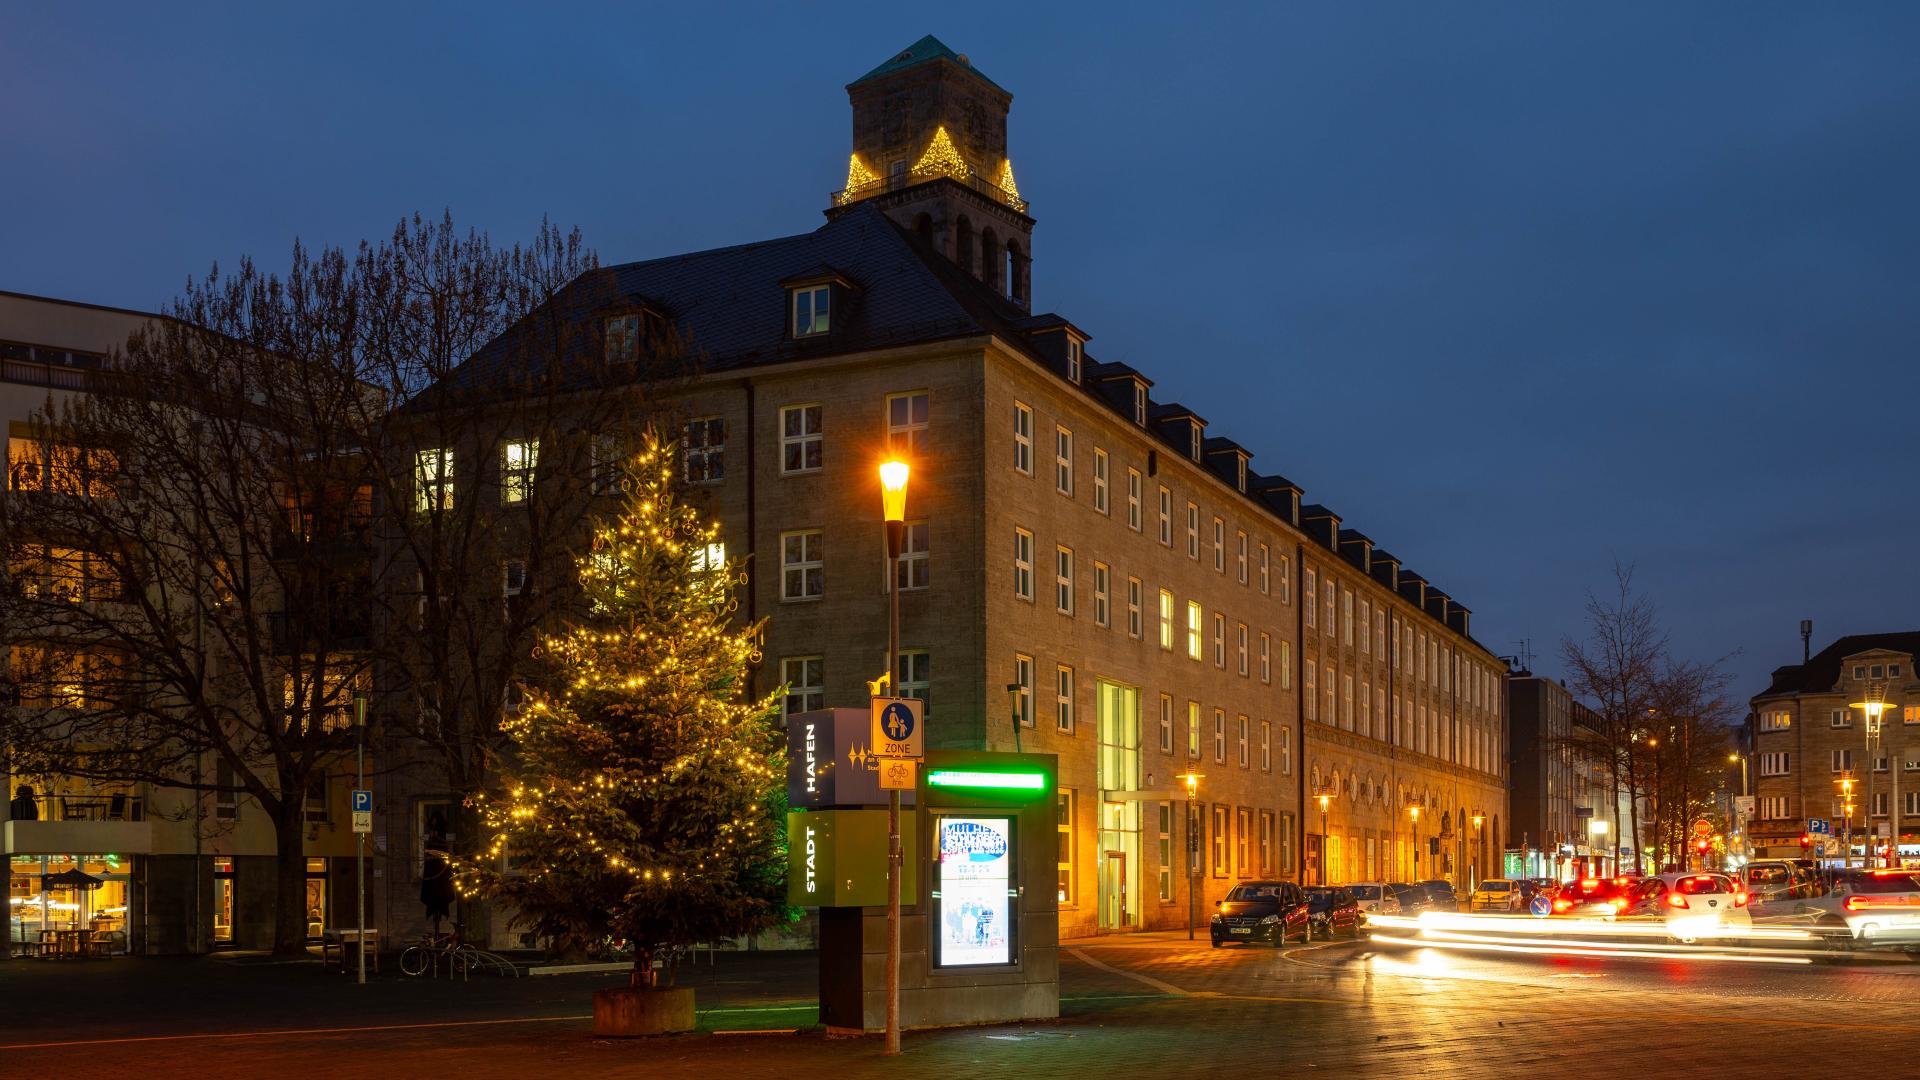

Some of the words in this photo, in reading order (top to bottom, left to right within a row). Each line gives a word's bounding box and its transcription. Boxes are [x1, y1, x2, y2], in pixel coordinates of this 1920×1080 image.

[885, 743, 911, 753] ZONE
[806, 724, 816, 792] HAFEN
[357, 793, 368, 809] P
[1811, 820, 1820, 831] P
[806, 826, 816, 893] STADT
